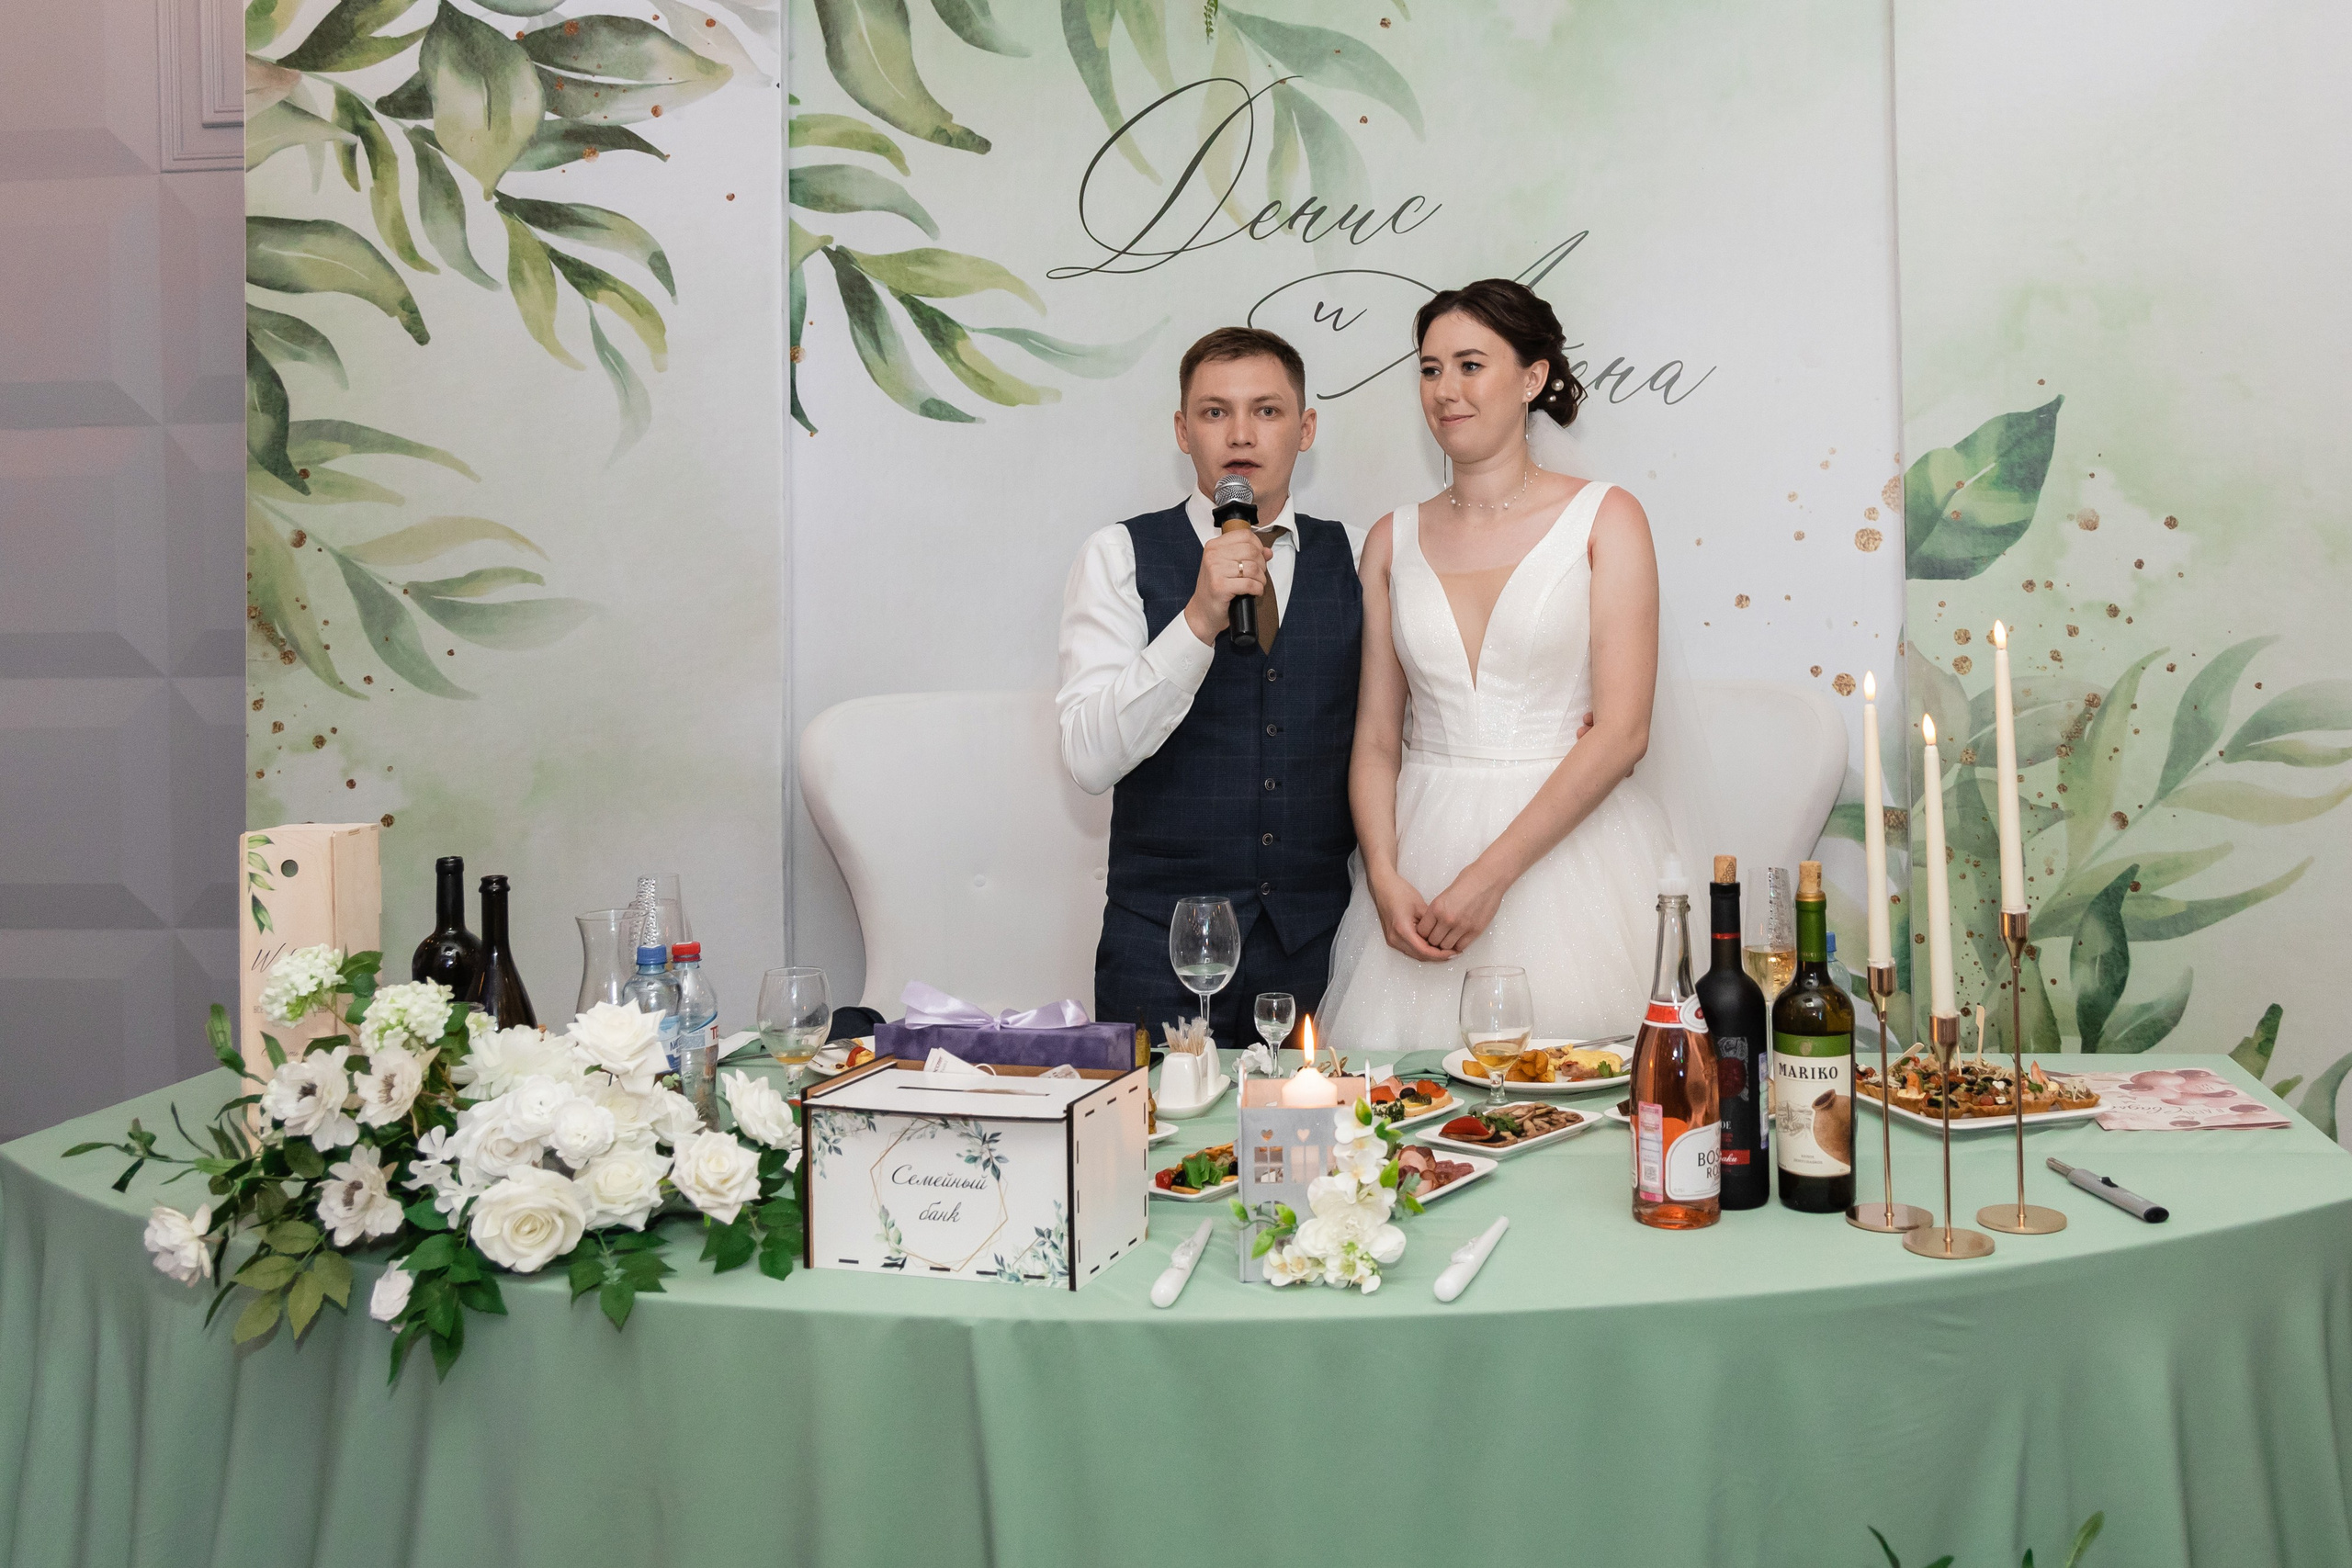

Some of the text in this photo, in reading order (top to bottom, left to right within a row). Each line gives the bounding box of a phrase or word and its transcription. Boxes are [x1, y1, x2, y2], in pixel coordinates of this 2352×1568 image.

[1046, 75, 1442, 280] Денис
[1314, 300, 1368, 332] и
[1779, 1062, 1838, 1080] MARIKO
[891, 1164, 988, 1190] Семейный
[918, 1201, 962, 1223] банк
